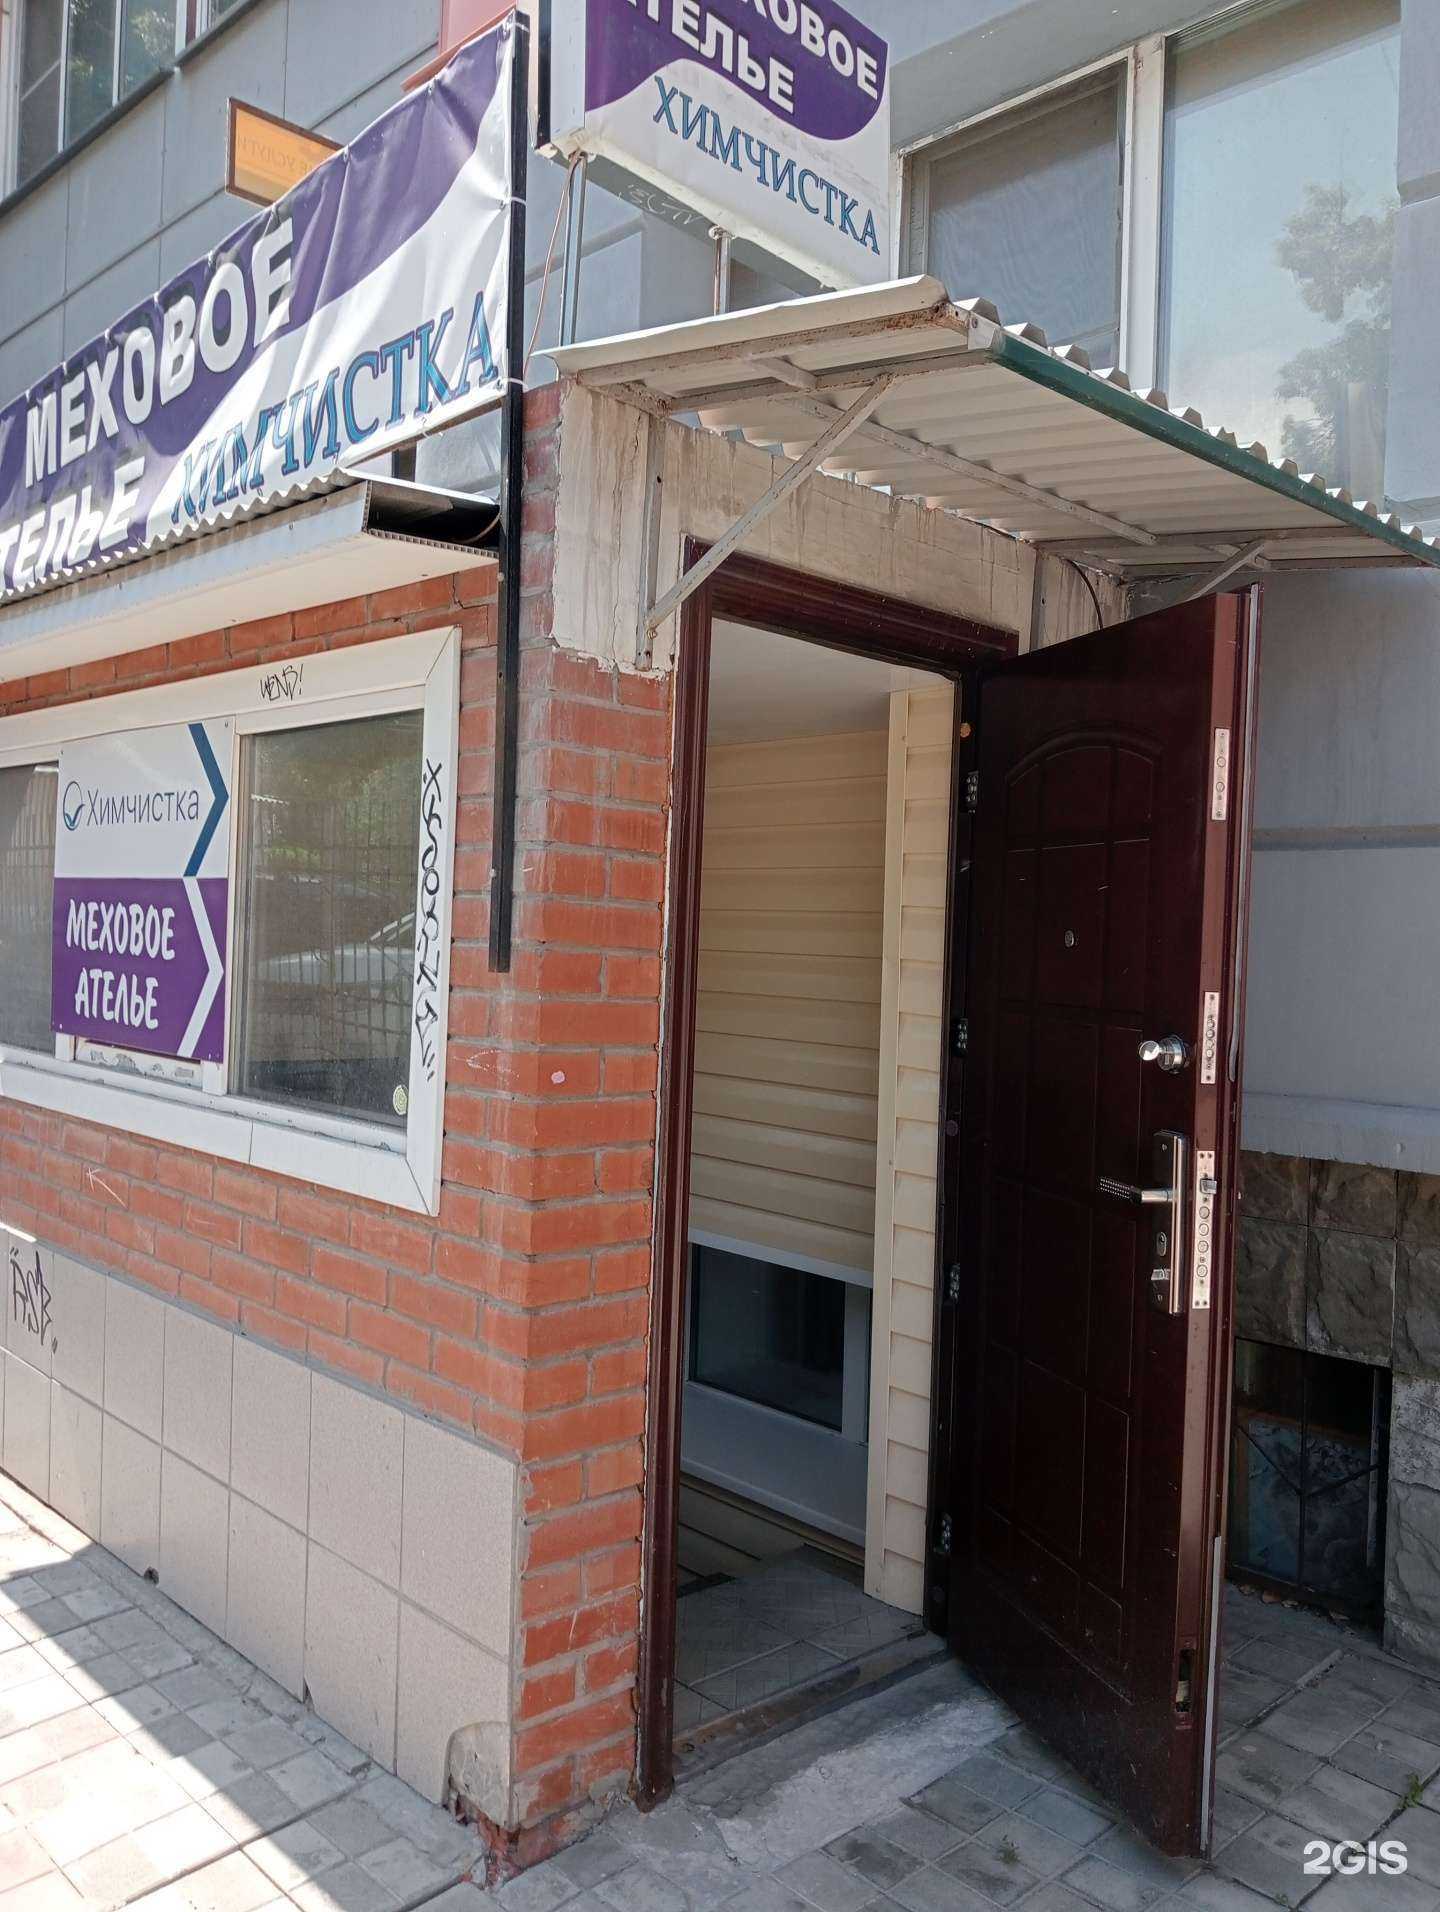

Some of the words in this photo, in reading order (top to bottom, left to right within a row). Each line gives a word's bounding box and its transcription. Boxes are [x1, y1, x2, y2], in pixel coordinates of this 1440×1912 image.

[630, 0, 794, 114] ЕЛЬЕ
[652, 75, 880, 256] ХИМЧИСТКА
[26, 217, 293, 489] МЕХОВОЕ
[171, 291, 499, 525] ХИМЧИСТКА
[86, 787, 200, 827] Химчистка
[66, 899, 176, 961] МЕХОВОЕ
[75, 967, 159, 1030] АТЕЛЬЕ
